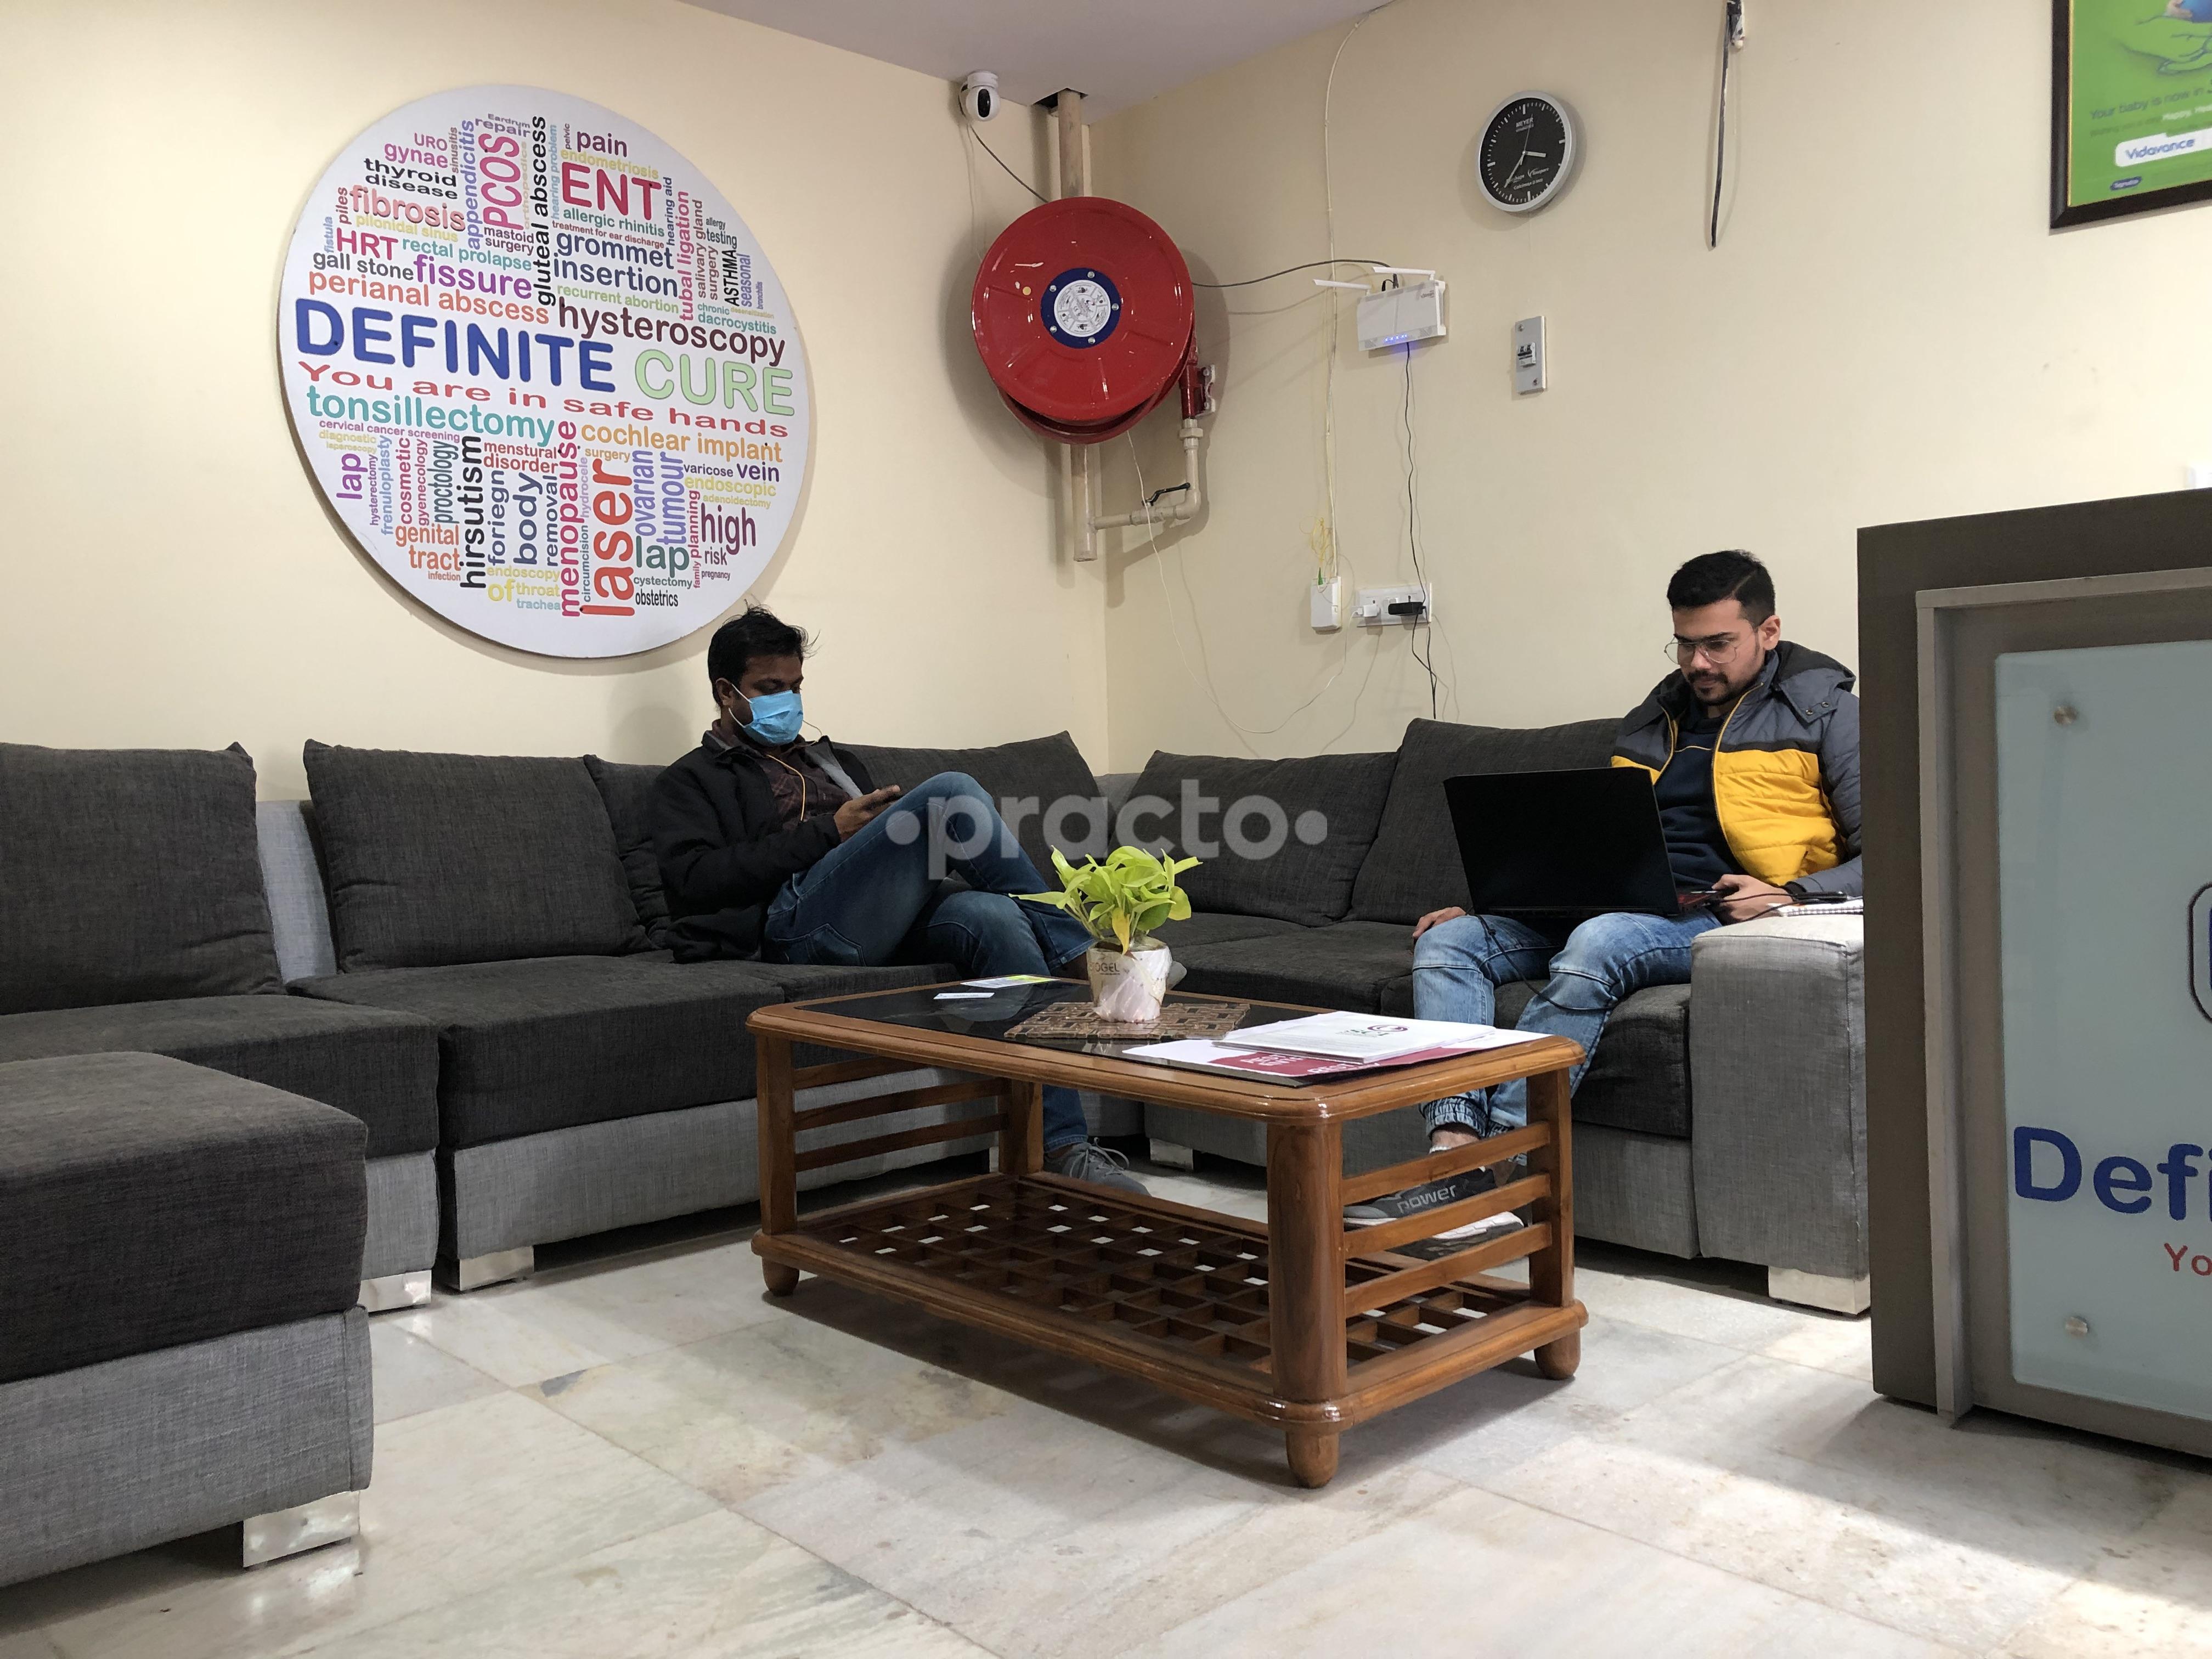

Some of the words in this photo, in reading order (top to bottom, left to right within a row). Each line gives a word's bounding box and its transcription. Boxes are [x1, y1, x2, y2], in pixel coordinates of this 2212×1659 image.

[475, 118, 531, 138] repair
[488, 114, 531, 129] Eardrum
[563, 123, 572, 150] pelvic
[385, 143, 448, 168] gynae
[414, 132, 448, 151] URO
[448, 127, 459, 174] sinusitis
[549, 125, 560, 173] problem
[577, 131, 627, 157] pain
[2125, 139, 2195, 160] Vidavance
[364, 158, 457, 187] thyroid
[478, 133, 524, 230] PCOS
[529, 116, 549, 217] abscess
[560, 149, 659, 179] endometriosis
[365, 174, 458, 200] disease
[458, 120, 484, 250] appendicitis
[522, 141, 530, 230] orthopedics
[551, 175, 561, 220] hearing
[562, 161, 662, 221] ENT
[663, 177, 672, 196] aid
[335, 187, 352, 225] piles
[349, 184, 466, 232] fibrosis
[563, 207, 615, 228] allergic
[619, 218, 665, 237] rhinitis
[664, 199, 675, 246] hearing
[692, 199, 706, 240] gland
[706, 217, 726, 230] allergy
[323, 216, 334, 253] fistula
[336, 227, 398, 261] HRT
[356, 214, 417, 235] pilonidal
[421, 226, 459, 242] sinus
[484, 227, 534, 244] mastoid
[485, 237, 534, 256] surgery
[552, 220, 594, 235] treatment
[595, 228, 607, 238] for
[624, 235, 664, 249] discharge
[675, 191, 695, 265] ligation
[706, 228, 737, 249] testing
[313, 252, 351, 270] gall
[357, 258, 414, 281] stone
[402, 238, 453, 258] rectal
[459, 247, 532, 271] prolapse
[531, 223, 556, 307] gluteal
[556, 233, 674, 270] grommet
[695, 242, 707, 298] salivary
[413, 254, 532, 299] fissure
[554, 252, 678, 297] insertion
[708, 245, 719, 301] surgery
[721, 250, 740, 307] ASTHMA
[736, 253, 752, 307] seasonal
[309, 271, 429, 307] perianal
[438, 289, 549, 325] abscess
[557, 284, 622, 305] recurrent
[624, 291, 679, 314] abortion
[677, 270, 693, 321] tubal
[697, 303, 730, 315] chronic
[559, 296, 785, 366] hysteroscopy
[698, 312, 776, 335] dacrocystitis
[296, 298, 616, 393] DEFINITE
[635, 349, 794, 416] CURE
[298, 361, 393, 391] You
[413, 381, 490, 401] are
[509, 388, 546, 408] in
[563, 399, 653, 421] safe
[669, 408, 788, 437] hands
[307, 385, 555, 447] tonsillectomy
[319, 420, 364, 432] cervical
[367, 425, 405, 436] cancer
[408, 430, 460, 443] screening
[319, 430, 376, 443] diagnostic
[484, 442, 557, 459] menstural
[581, 424, 690, 452] cochlear
[698, 432, 783, 462] implant
[483, 453, 558, 474] disorder
[585, 448, 630, 462] surgery
[684, 464, 733, 477] varicose
[736, 462, 780, 482] vein
[336, 453, 368, 499] lap
[368, 454, 381, 526] hysterectomy
[377, 435, 394, 536] frenuloplasty
[396, 437, 413, 524] cosmetic
[414, 439, 430, 526] gyenecology
[427, 440, 460, 524] proctology
[578, 457, 591, 518] hydrocele
[632, 450, 657, 536] ovarian
[685, 476, 776, 498] endoscopic
[456, 436, 486, 588] hirsutism
[656, 451, 686, 545] tumour
[395, 523, 459, 548] genital
[487, 470, 509, 566] foriegn
[512, 472, 543, 565] body
[543, 475, 558, 567] removal
[558, 421, 585, 617] menopause
[579, 458, 635, 616] laser
[686, 490, 701, 558] planning
[701, 502, 756, 555] high
[409, 545, 461, 571] tract
[487, 566, 560, 582] endoscopy
[579, 525, 591, 602] circumcision
[636, 535, 690, 578] lap
[692, 561, 701, 589] family
[701, 569, 730, 581] pregnancy
[704, 546, 727, 566] risk
[428, 571, 461, 582] infection
[488, 579, 515, 601] of
[516, 582, 560, 597] throat
[633, 577, 692, 589] cystectomy
[516, 598, 561, 611] trachea
[635, 589, 679, 607] obstetrics
[2013, 1126, 2212, 1222] Def
[1397, 1184, 1456, 1214] power
